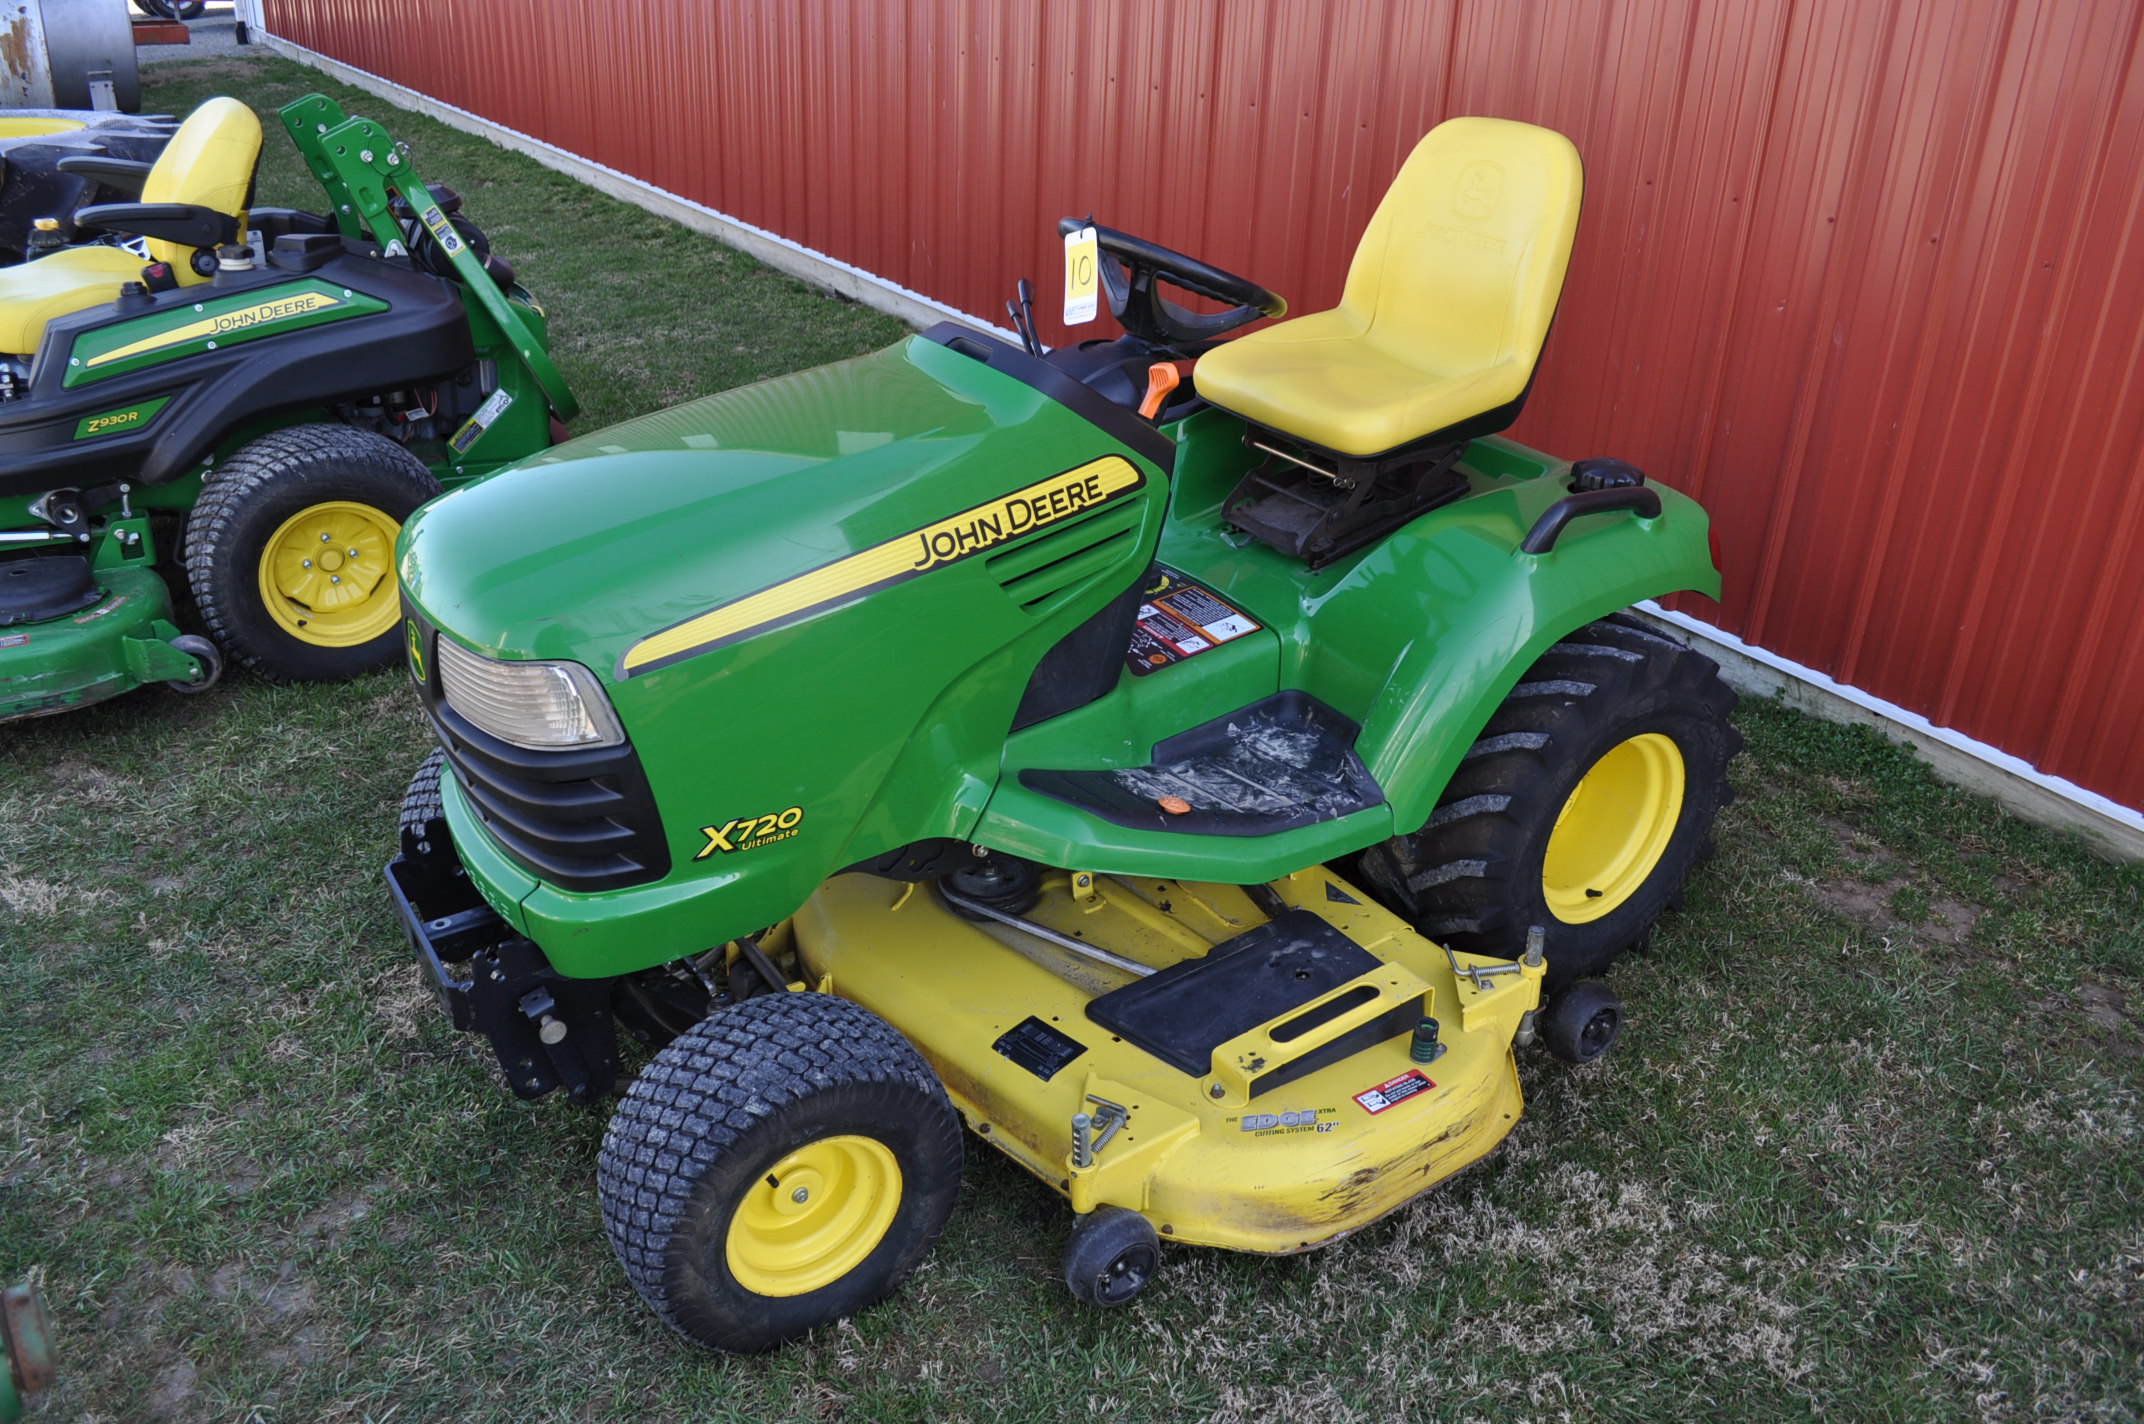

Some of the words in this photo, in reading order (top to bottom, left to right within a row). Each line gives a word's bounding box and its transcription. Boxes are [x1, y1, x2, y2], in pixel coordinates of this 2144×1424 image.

[1071, 255, 1092, 290] 10
[209, 312, 257, 334] JOHN
[259, 297, 317, 320] DEERE
[88, 411, 139, 433] Z930R
[914, 513, 1003, 568] JOHN
[1005, 474, 1104, 531] DEERE
[693, 806, 804, 861] X720
[741, 829, 799, 851] Ultimate
[1241, 1109, 1317, 1132] EDGE
[1255, 1129, 1285, 1137] CUTTING
[1286, 1126, 1314, 1134] SYSTEM
